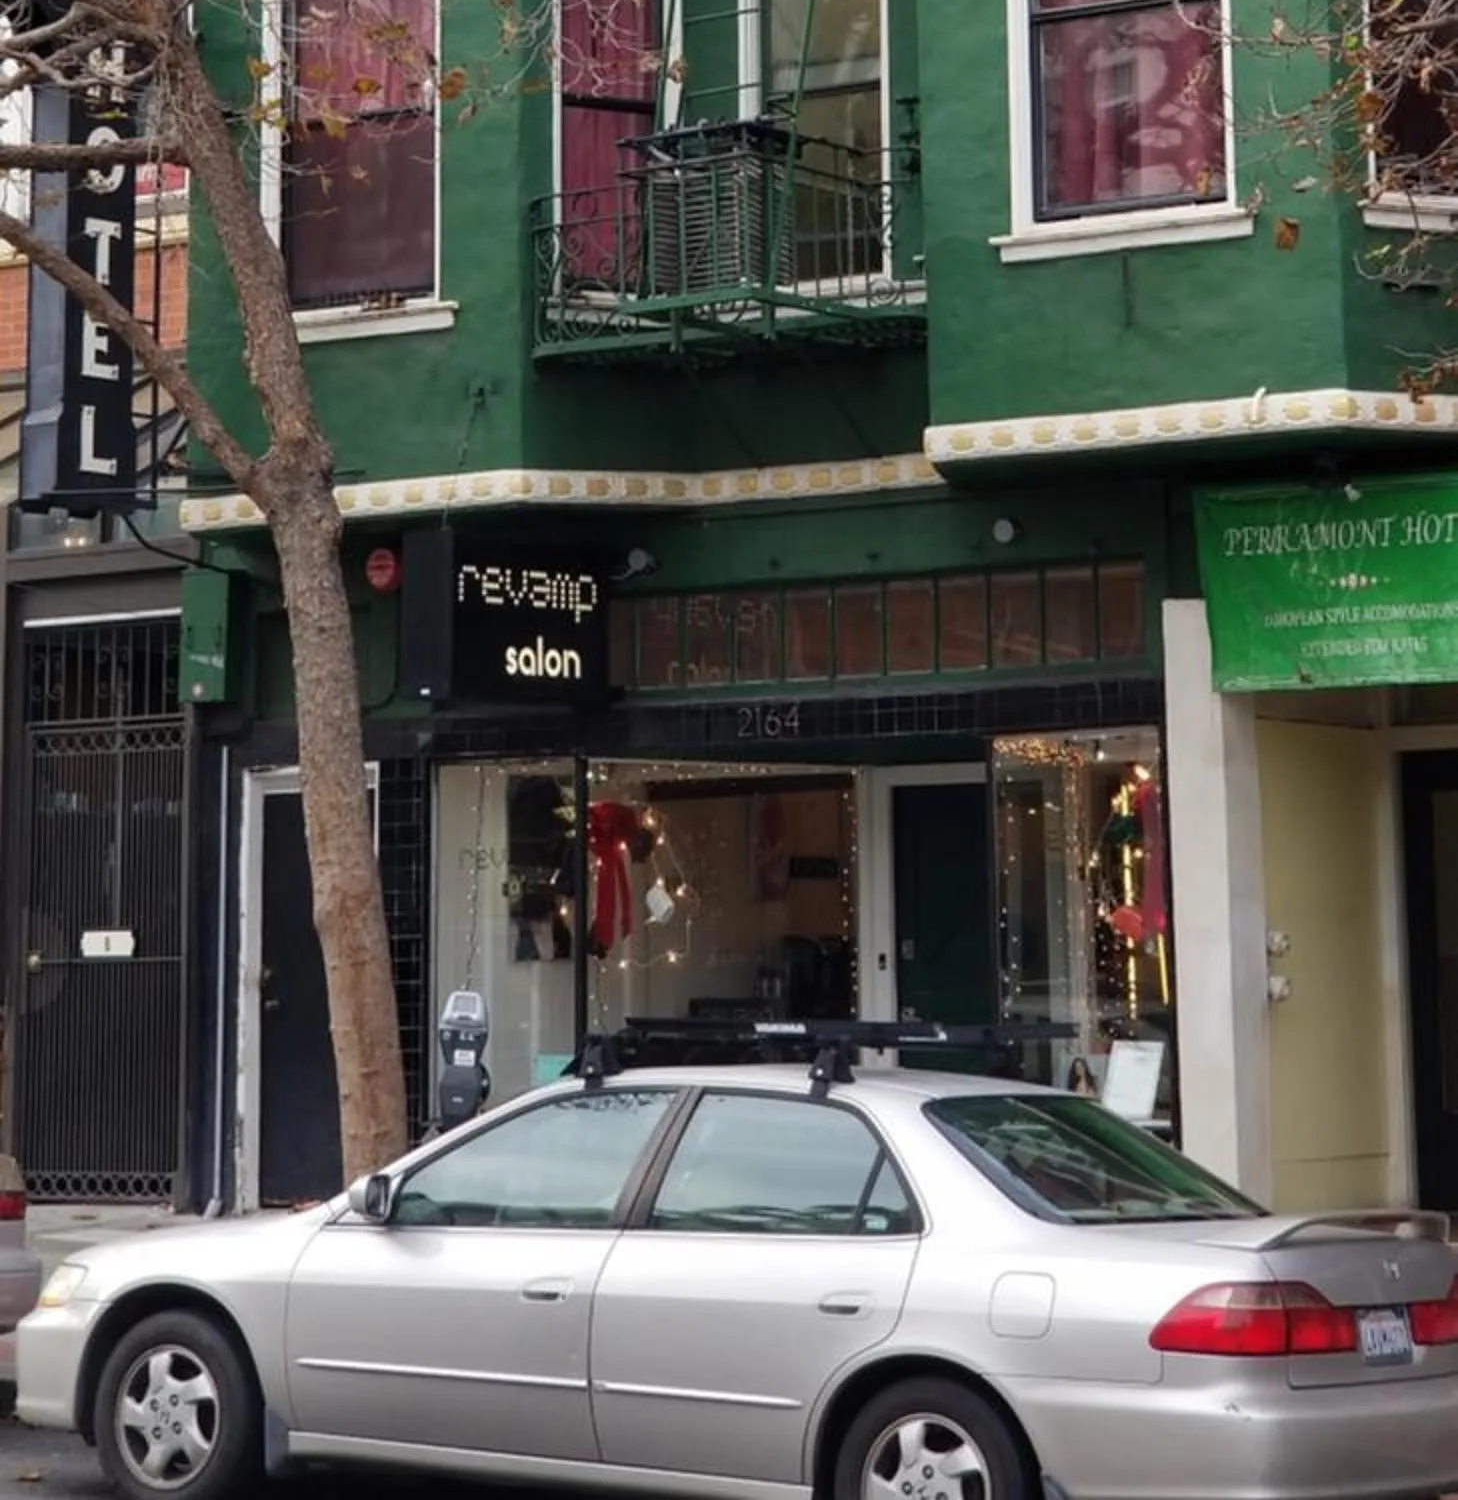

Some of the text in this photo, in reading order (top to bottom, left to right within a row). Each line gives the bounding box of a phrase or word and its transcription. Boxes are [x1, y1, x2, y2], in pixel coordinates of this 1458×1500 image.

[79, 40, 126, 476] HOTEL
[1224, 514, 1395, 557] PERRAMONT
[458, 564, 598, 623] revamp
[1325, 606, 1361, 625] STYLE
[505, 635, 582, 679] salon
[737, 706, 801, 738] 2164
